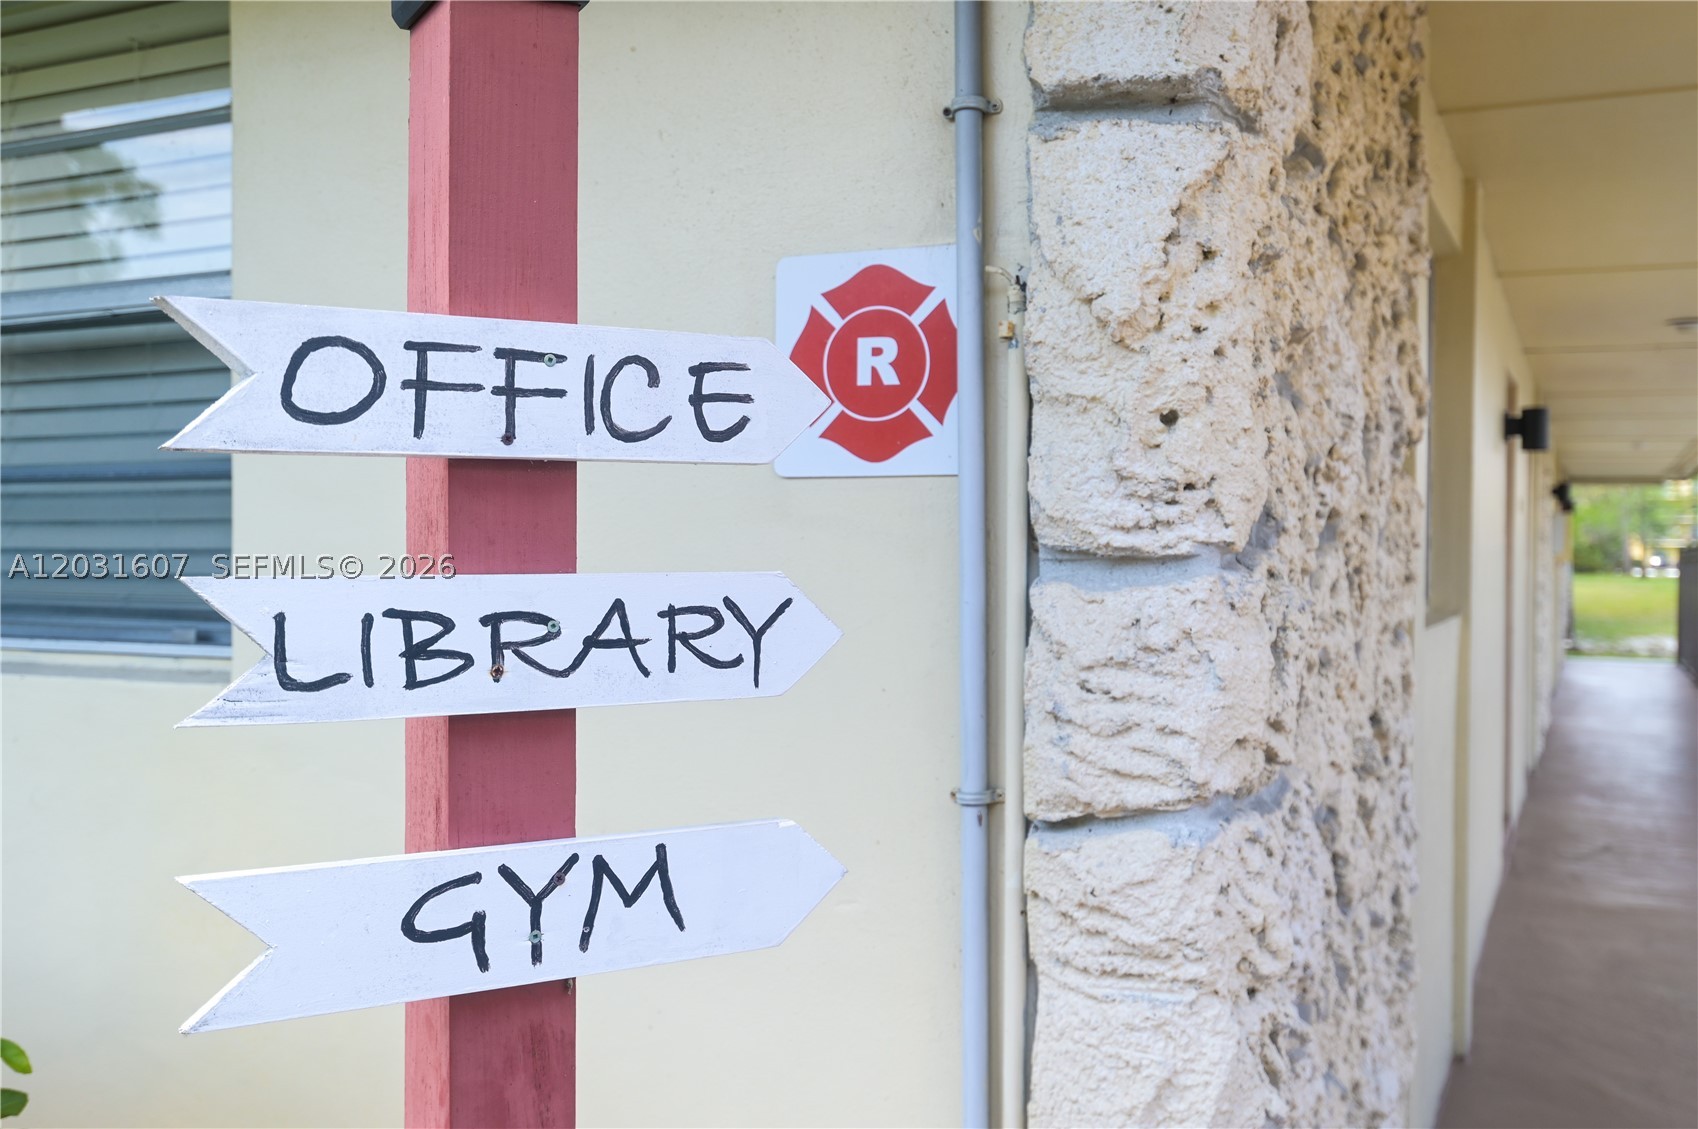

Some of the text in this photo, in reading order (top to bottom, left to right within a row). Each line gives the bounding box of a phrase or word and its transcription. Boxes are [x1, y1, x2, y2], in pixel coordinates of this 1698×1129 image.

[280, 335, 755, 446] OFFICE
[856, 336, 901, 387] R
[273, 596, 793, 693] LIBRARY
[400, 842, 686, 974] GYM
